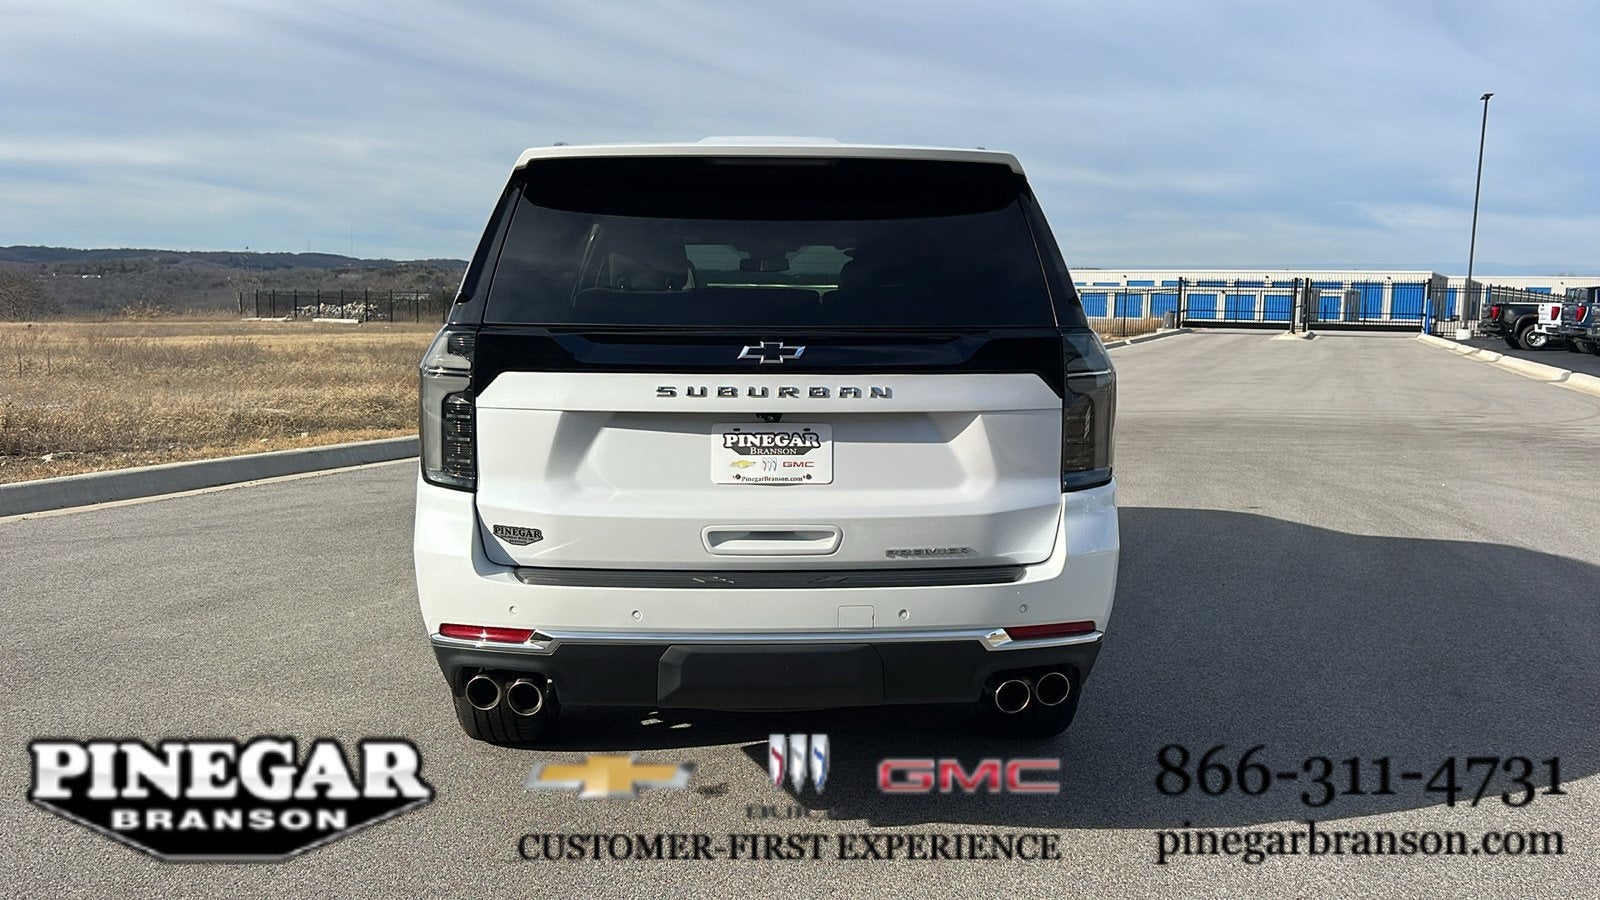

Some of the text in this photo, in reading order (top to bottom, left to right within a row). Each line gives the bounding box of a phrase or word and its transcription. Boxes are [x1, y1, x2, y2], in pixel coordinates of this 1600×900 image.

[656, 386, 893, 399] SUBURBAN
[724, 433, 821, 448] PINEGAR
[494, 526, 541, 538] PINEGAR
[885, 547, 972, 558] PREMIER
